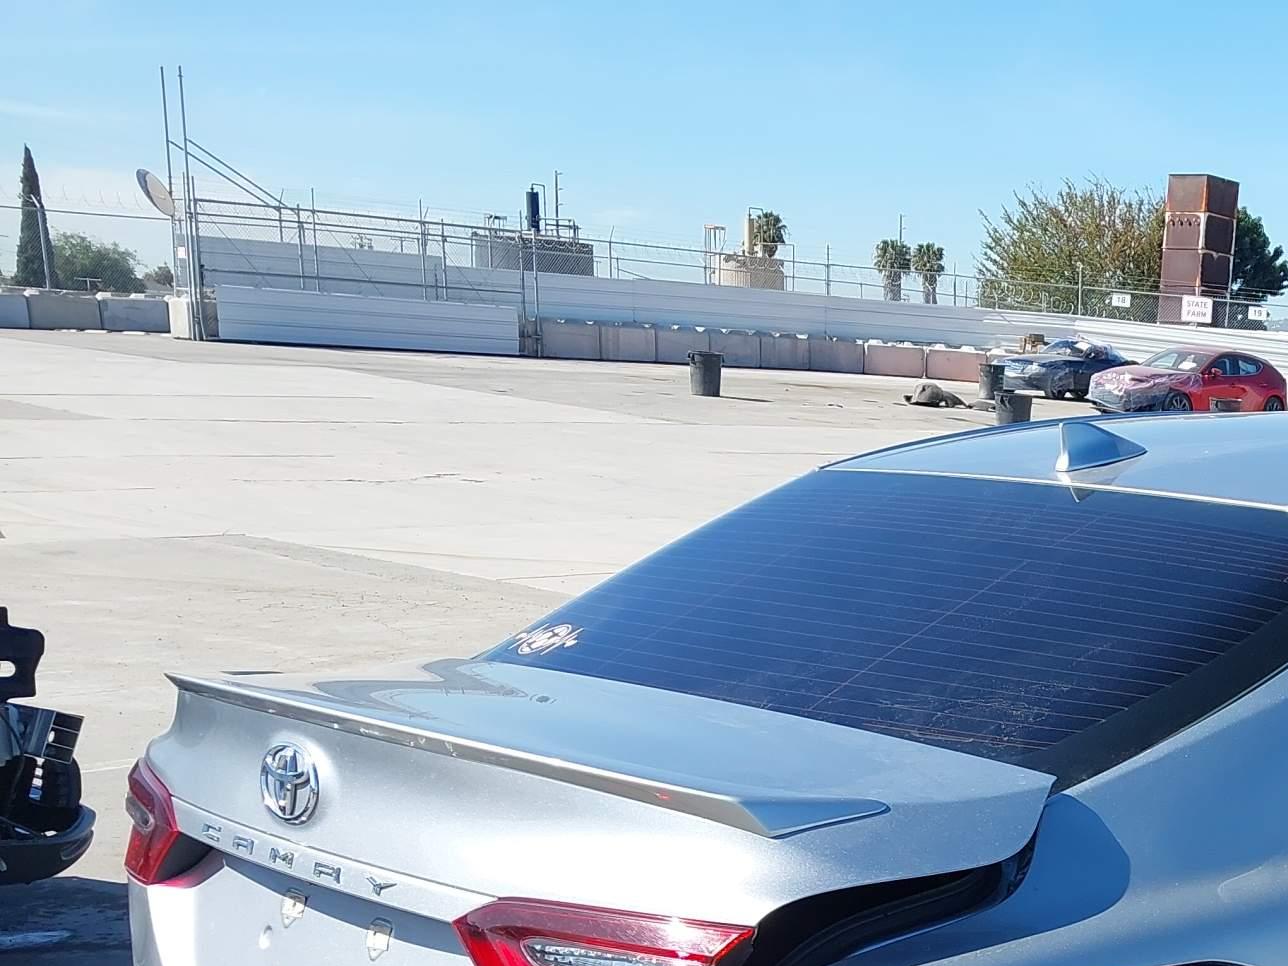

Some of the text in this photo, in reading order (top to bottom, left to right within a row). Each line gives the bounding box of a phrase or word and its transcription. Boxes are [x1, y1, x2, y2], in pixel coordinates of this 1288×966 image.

[1186, 300, 1209, 309] STATE
[1186, 309, 1207, 318] FARM
[1253, 309, 1263, 317] 19
[202, 823, 398, 897] CAMRY
